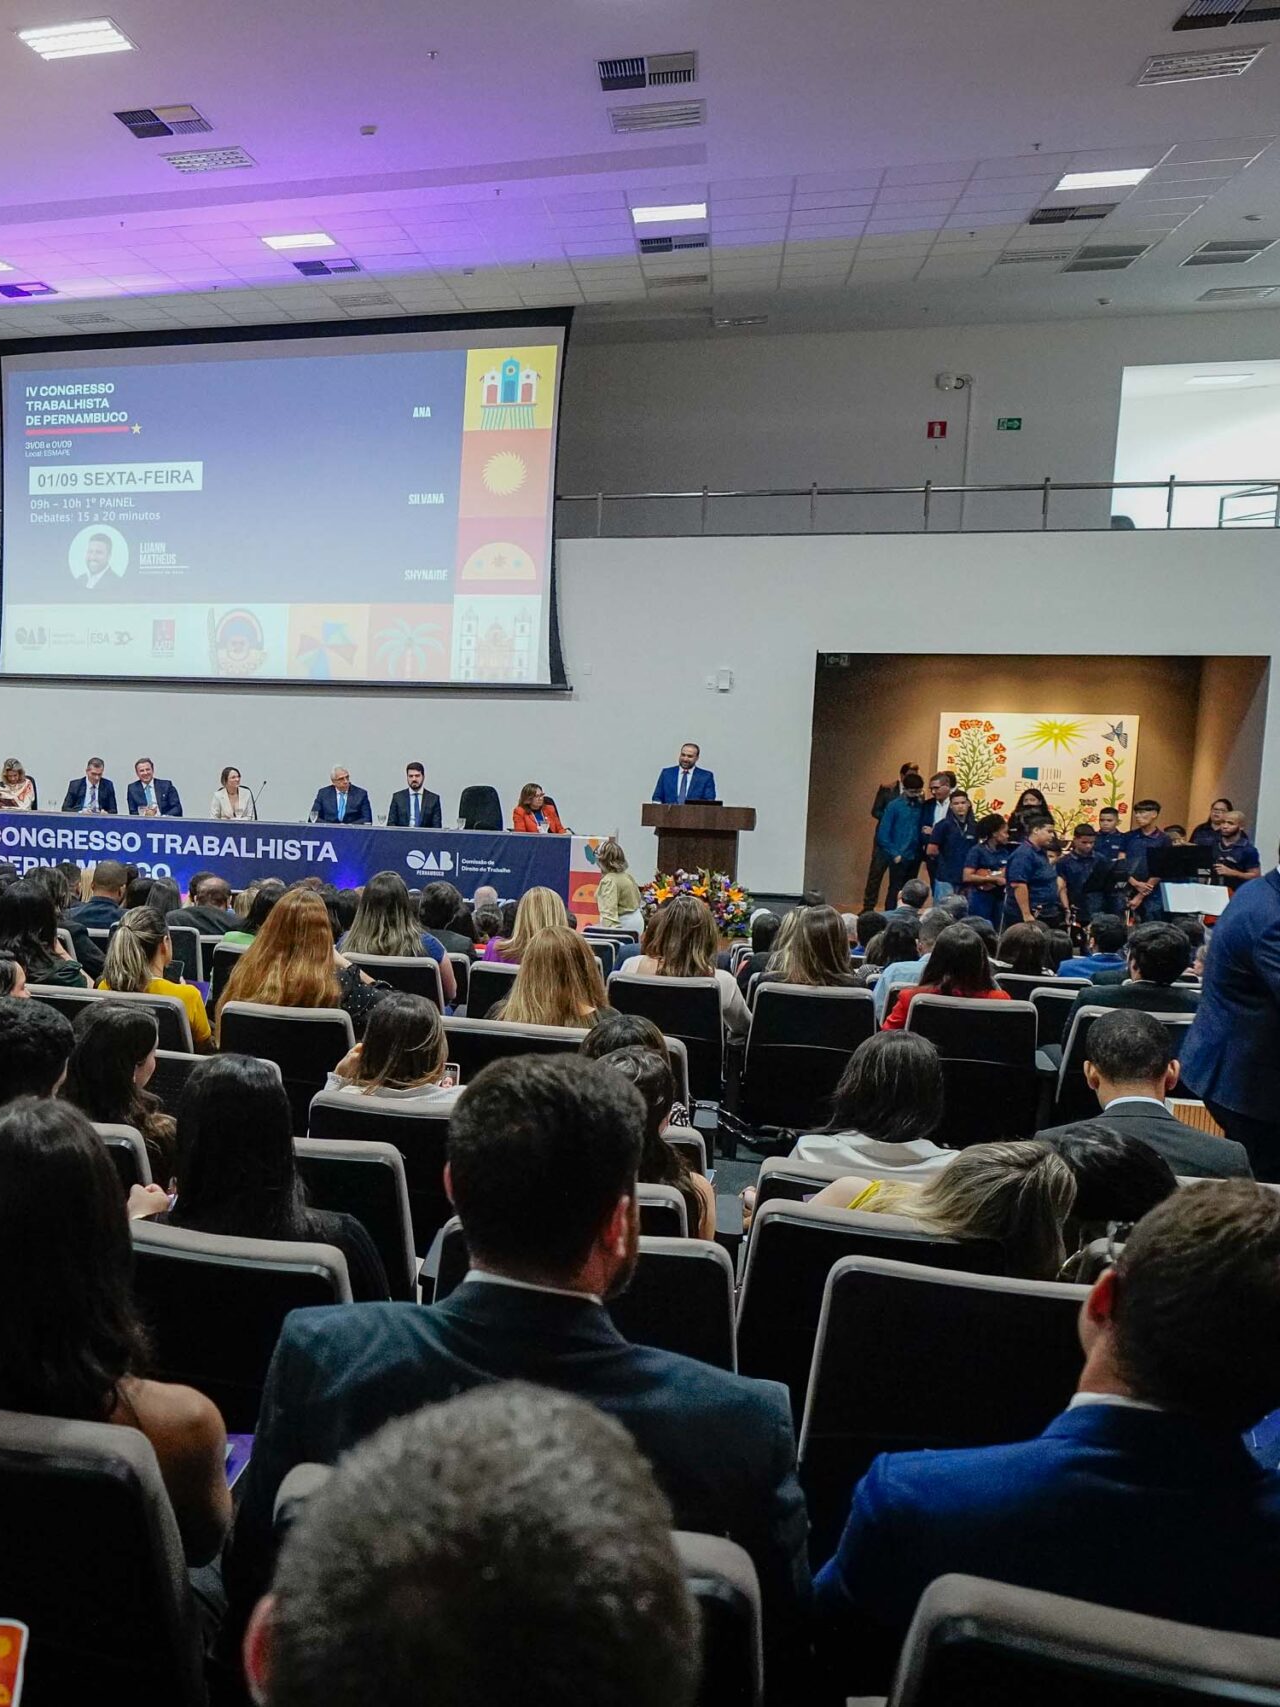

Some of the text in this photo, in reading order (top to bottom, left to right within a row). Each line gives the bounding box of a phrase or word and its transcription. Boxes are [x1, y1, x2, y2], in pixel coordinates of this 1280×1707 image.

[26, 383, 114, 397] IV CONGRESSO
[26, 398, 109, 412] TRABALHISTA
[25, 411, 128, 426] DE PERNAMBUCO
[413, 407, 431, 418] ANA
[25, 441, 45, 450] 31/08
[52, 440, 72, 449] 01/09
[37, 469, 194, 488] 01/09 SEXTA-FEIRA
[30, 499, 50, 510] 09h
[63, 498, 82, 509] 10h
[99, 497, 135, 508] PAINEL
[408, 493, 444, 505] SILVANA
[30, 512, 72, 523] Debates:
[77, 512, 90, 522] 15
[102, 511, 116, 521] 20
[119, 510, 160, 521] minutos
[139, 553, 177, 565] MATHEUS
[1014, 781, 1066, 793] ESMAPE
[147, 832, 339, 863] TRABALHISTA
[406, 850, 454, 871] OAB
[461, 858, 487, 866] Comissão
